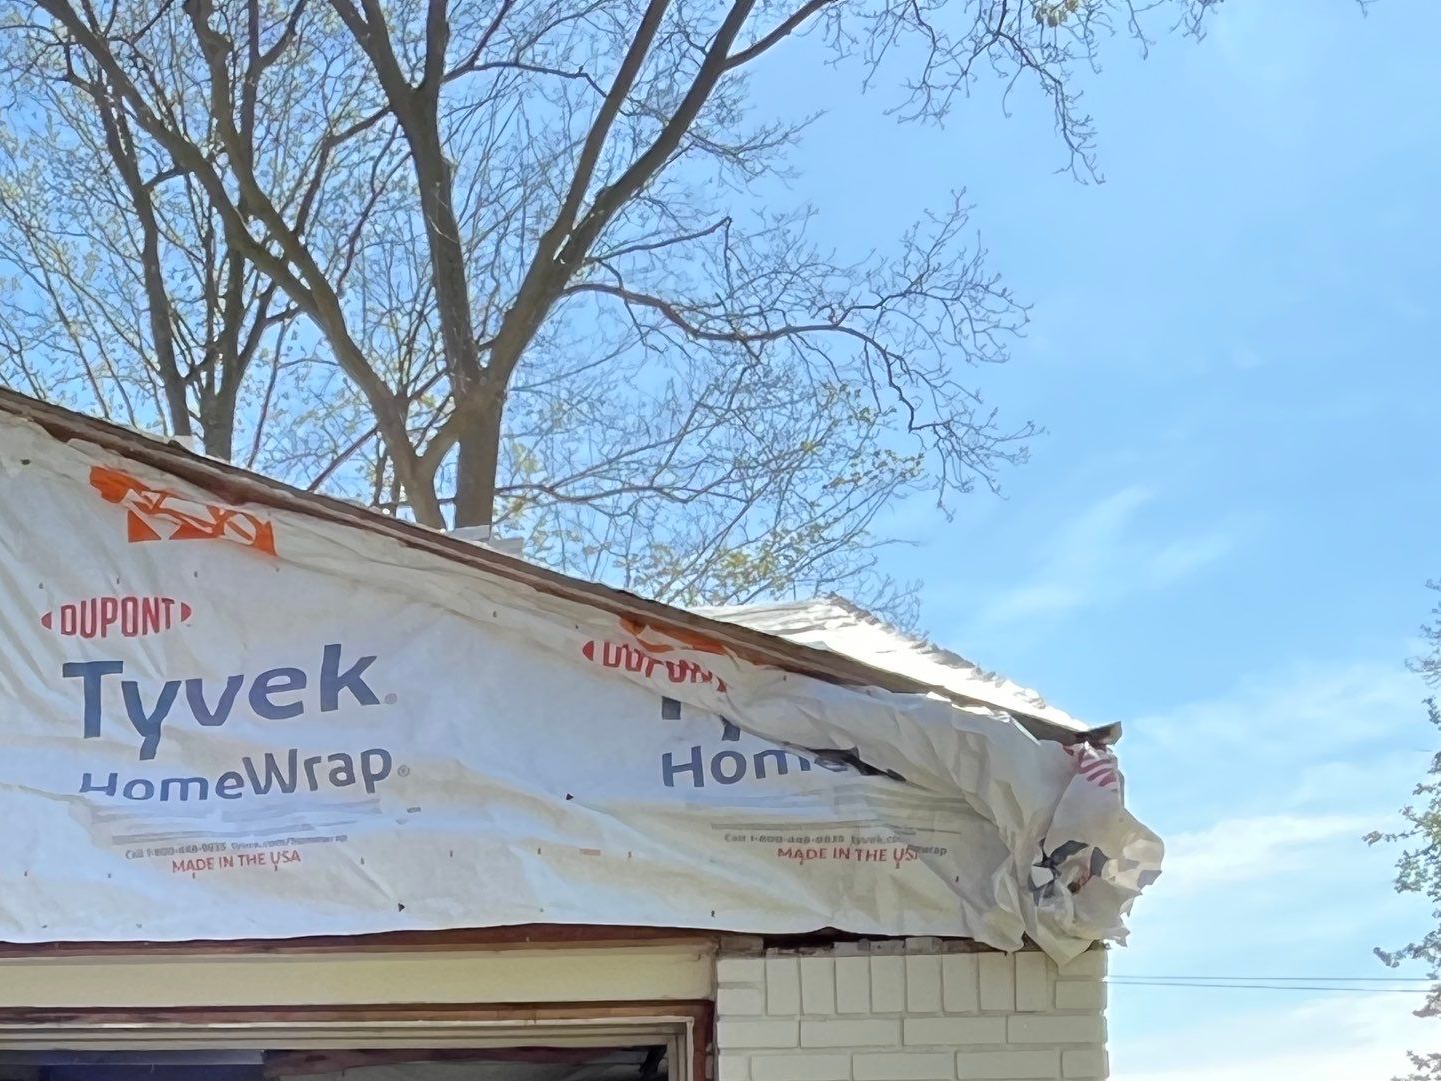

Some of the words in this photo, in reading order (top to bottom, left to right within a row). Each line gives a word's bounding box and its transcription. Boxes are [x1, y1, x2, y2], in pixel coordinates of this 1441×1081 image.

[60, 596, 176, 639] DUPONT
[62, 643, 380, 761] Tyvek
[78, 748, 392, 801] HomeWrap
[172, 857, 215, 873] MADE
[219, 855, 234, 868] IN
[238, 852, 266, 866] THE
[270, 850, 301, 865] USA
[777, 848, 827, 859] MADE
[832, 847, 850, 860] IN
[855, 848, 887, 861] THE
